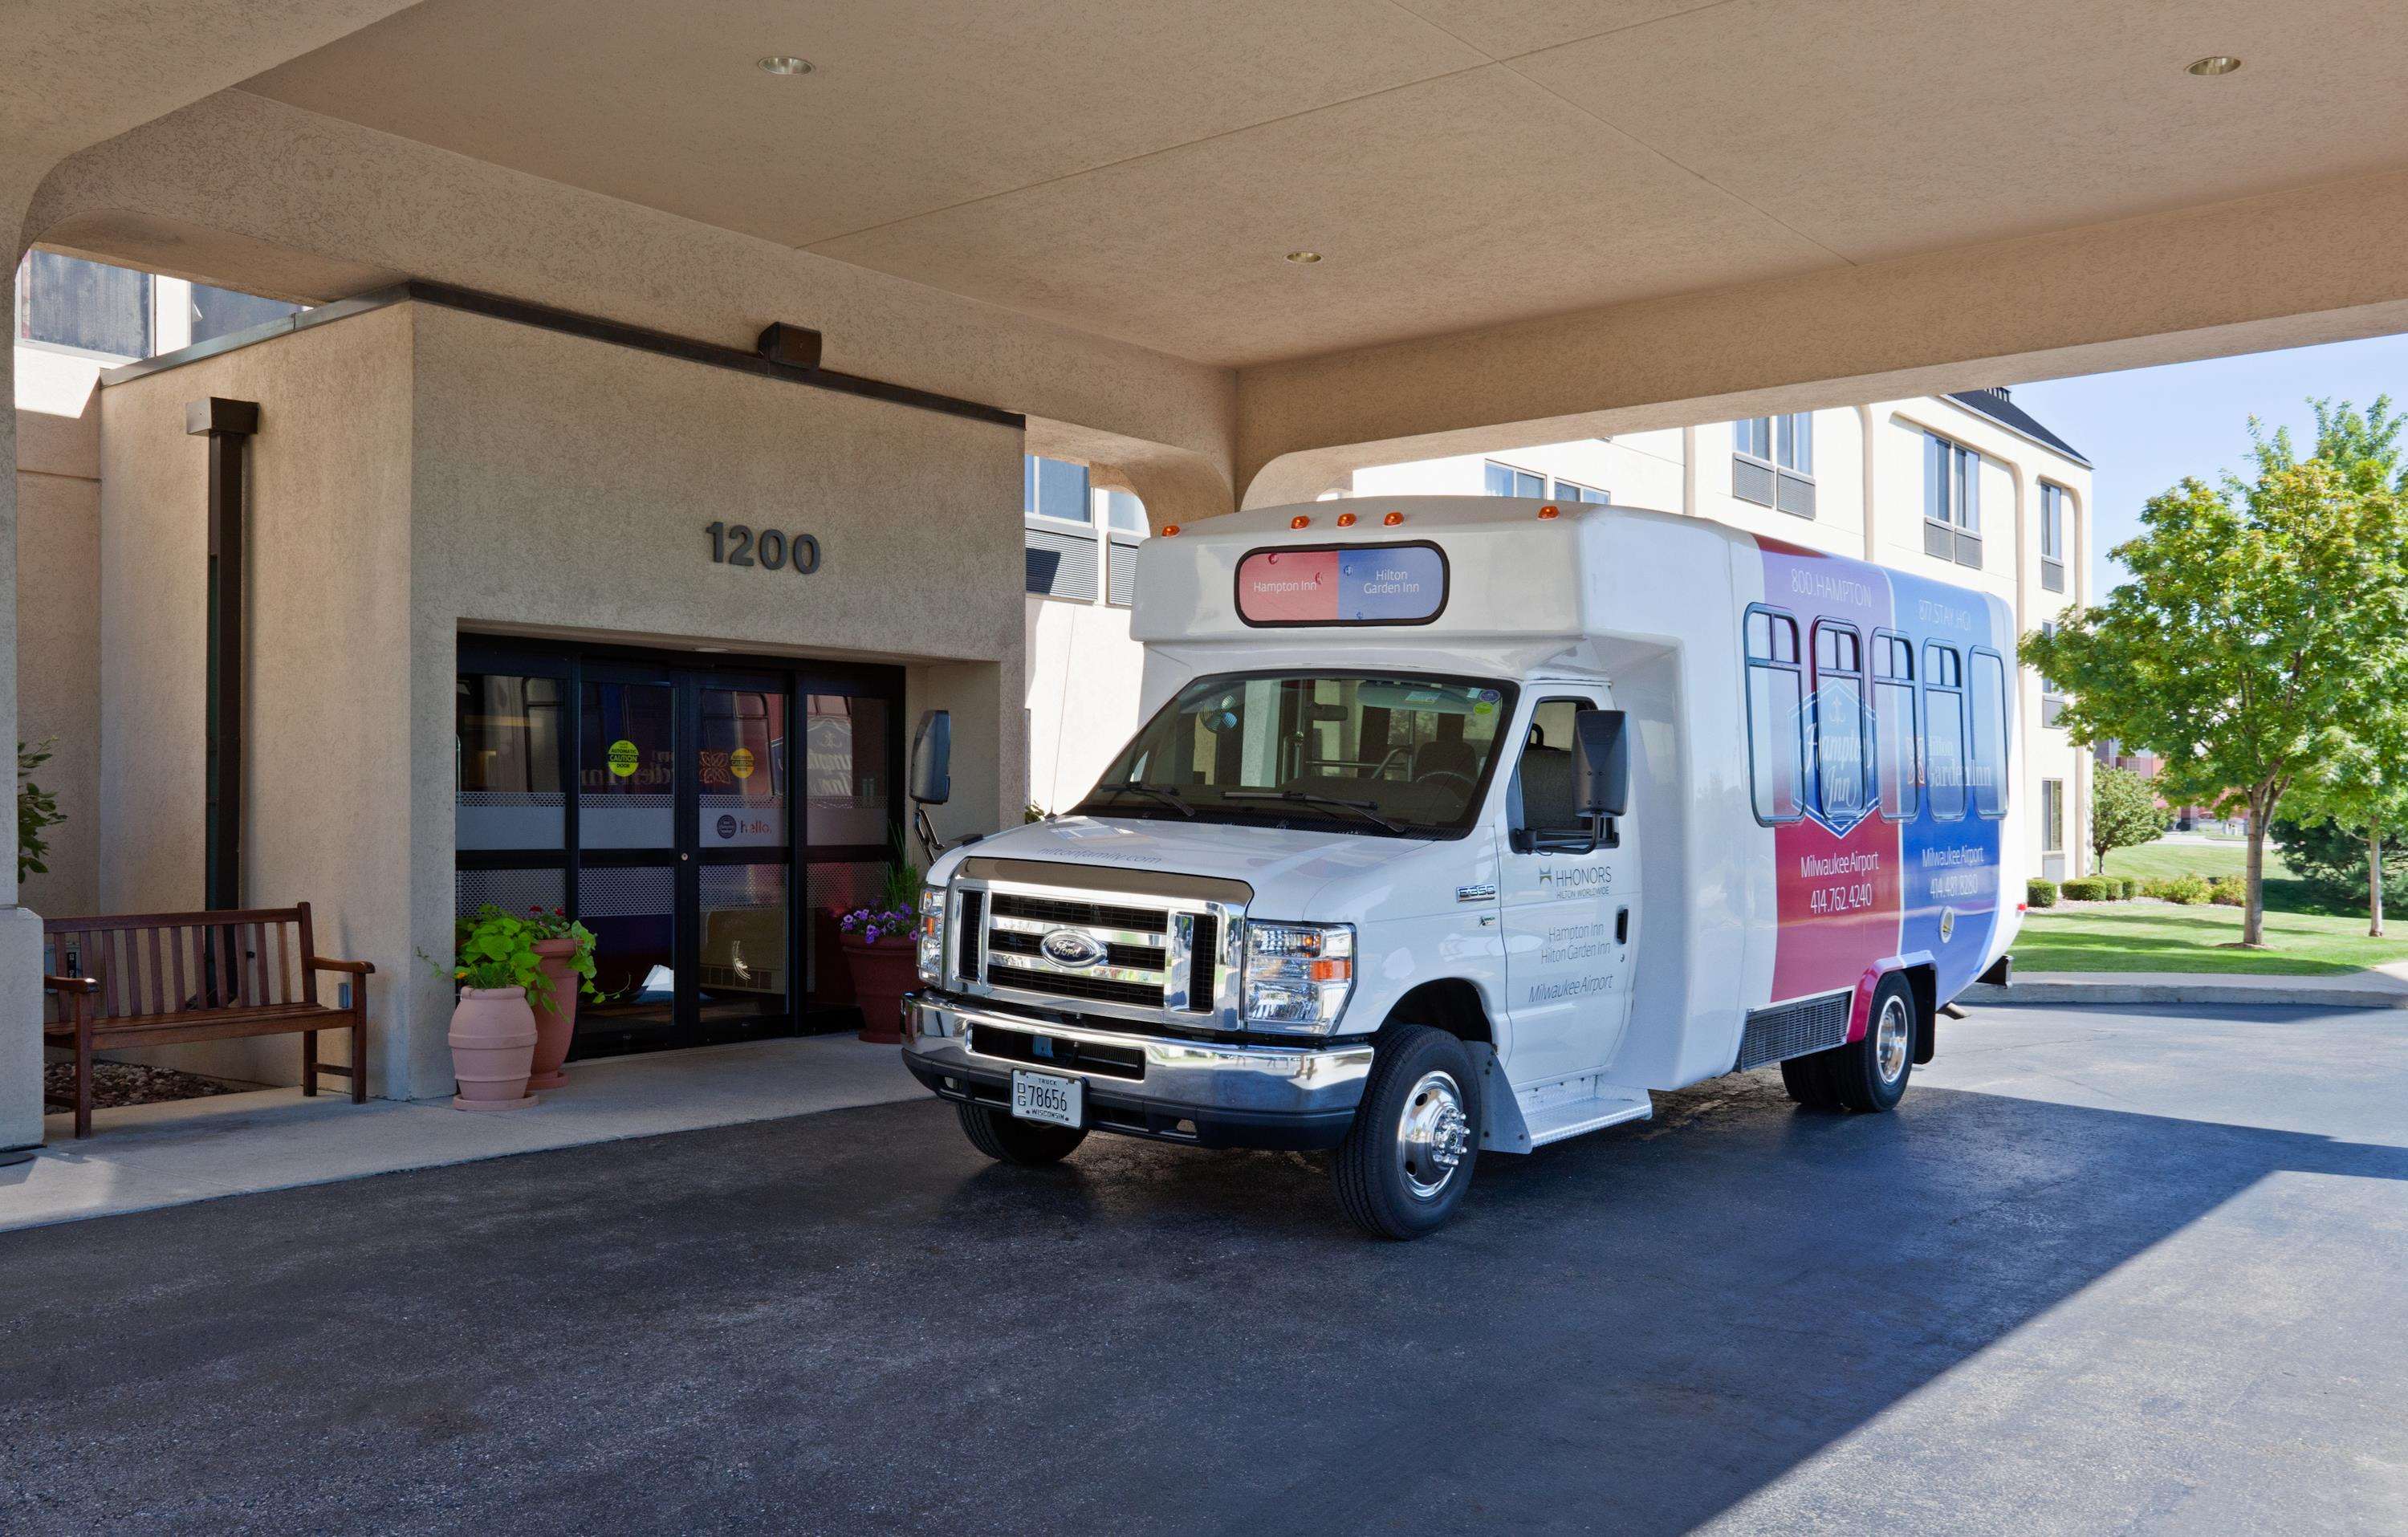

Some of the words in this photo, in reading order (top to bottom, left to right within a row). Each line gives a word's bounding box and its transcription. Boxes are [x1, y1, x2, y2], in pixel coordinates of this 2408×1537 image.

[706, 521, 821, 575] 1200
[1376, 569, 1407, 581] Hilton
[1253, 580, 1299, 594] Hampton
[1301, 579, 1317, 592] Inn
[1364, 582, 1401, 594] Garden
[1403, 582, 1420, 593] Inn
[609, 754, 638, 762] CAUTION
[1803, 722, 1874, 774] Hampto
[1800, 852, 1849, 879] Milwaukee
[1849, 850, 1880, 877] Airport
[1922, 845, 1960, 868] Milwaukee
[1960, 844, 1984, 867] Airport
[1556, 866, 1612, 887] HHONORS
[1810, 883, 1873, 914] 414.762.4240
[1548, 925, 1589, 943] Hampton
[1591, 922, 1605, 937] Inn
[1053, 940, 1083, 958] Ford
[1541, 946, 1566, 964] Hilton
[1567, 942, 1597, 960] Garden
[1597, 941, 1611, 955] Inn
[1528, 978, 1580, 1002] Milwaukee
[1580, 974, 1614, 995] Airport
[1038, 1078, 1057, 1086] TRUCK
[1027, 1084, 1068, 1112] 78656
[1031, 1108, 1065, 1121] WISCONSIN
